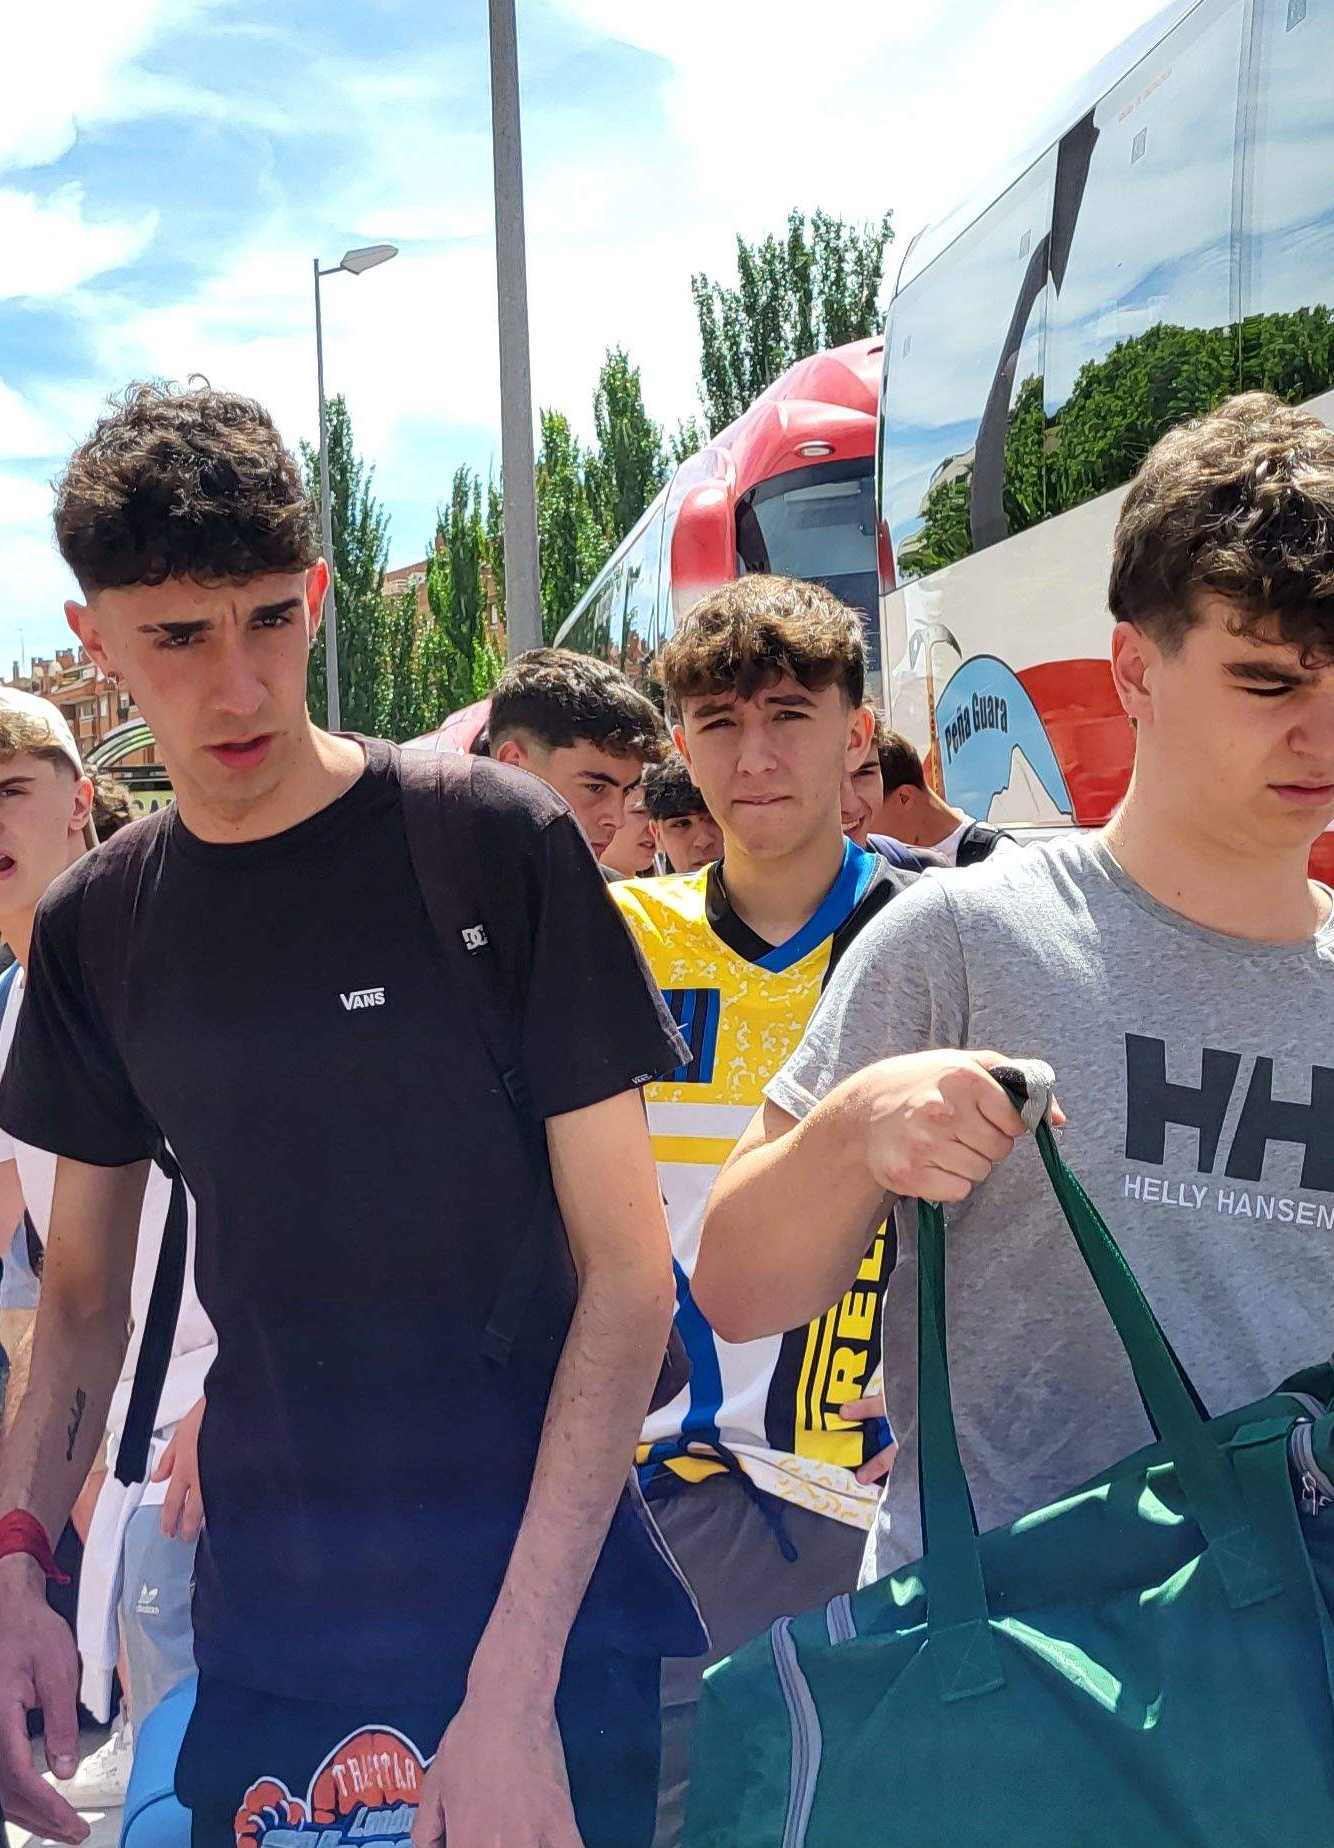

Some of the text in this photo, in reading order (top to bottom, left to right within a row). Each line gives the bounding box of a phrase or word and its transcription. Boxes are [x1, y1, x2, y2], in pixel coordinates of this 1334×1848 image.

[971, 692, 1008, 734] Guara
[339, 987, 386, 1011] VANS
[1124, 1174, 1208, 1209] HELLY
